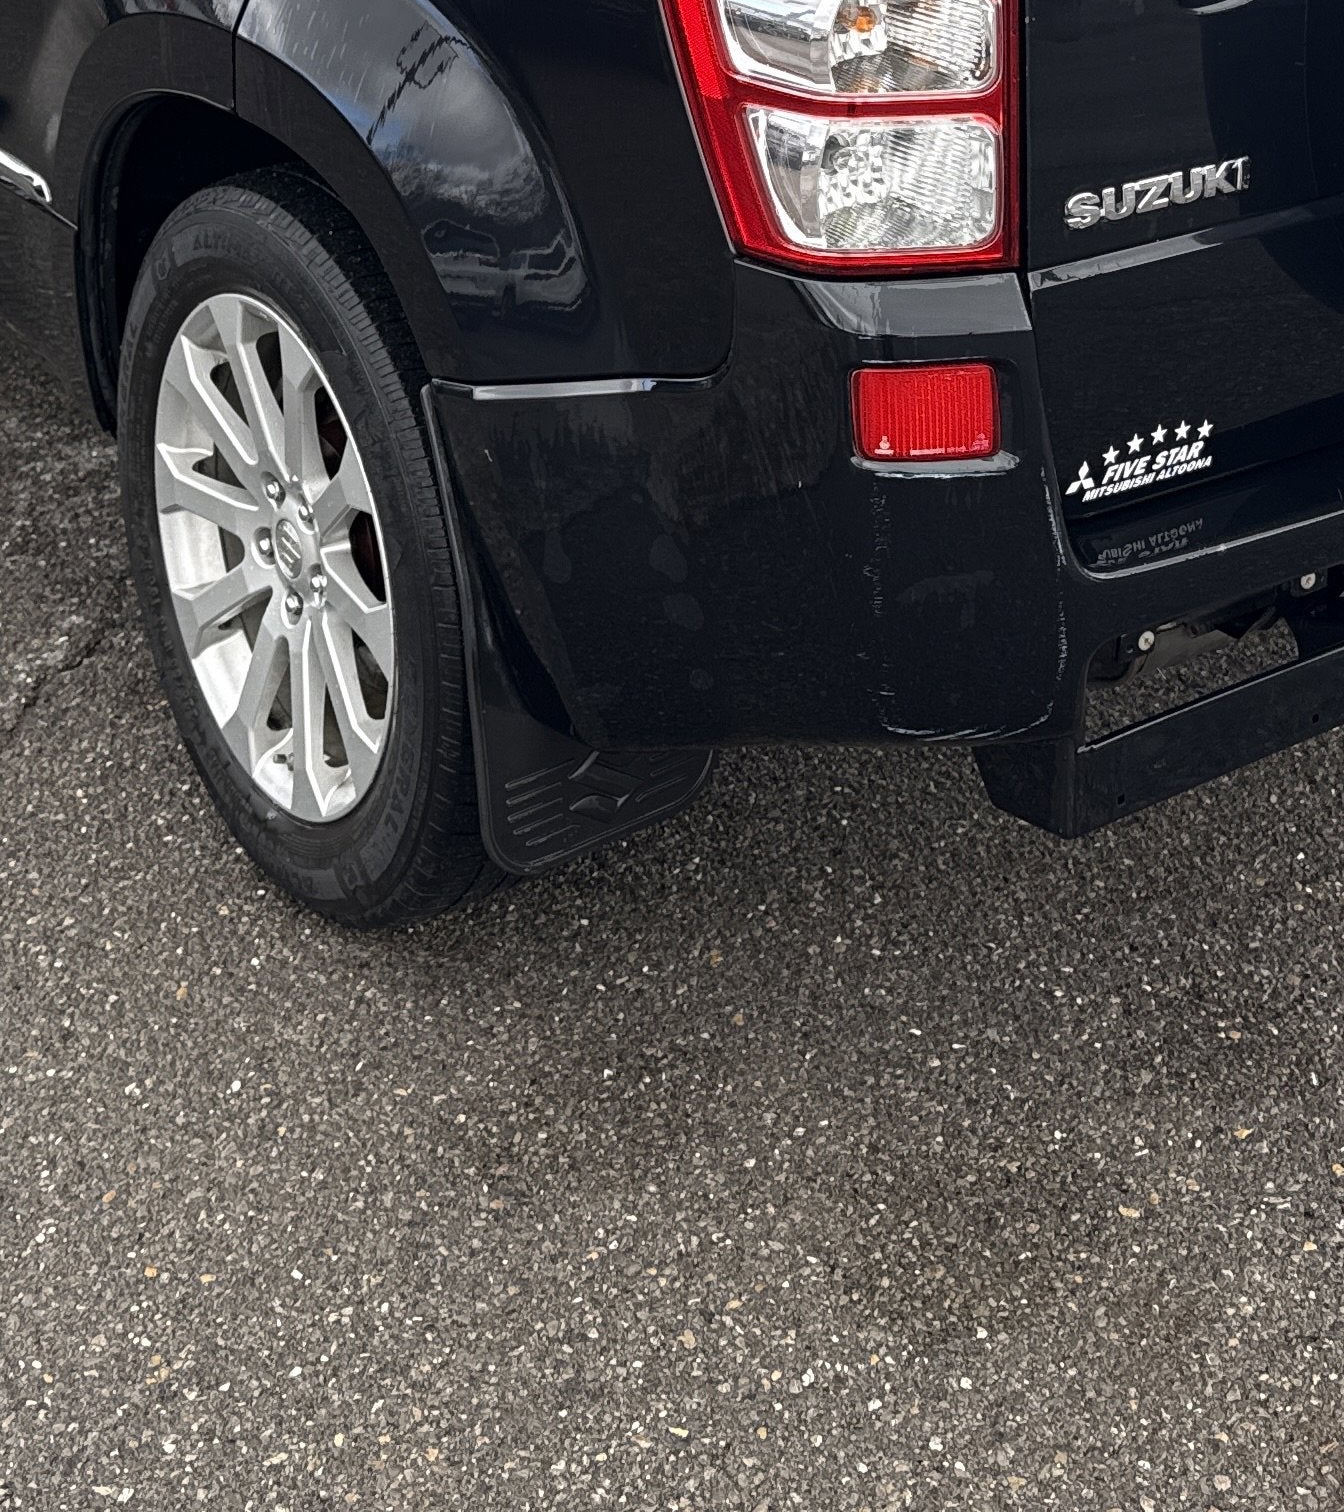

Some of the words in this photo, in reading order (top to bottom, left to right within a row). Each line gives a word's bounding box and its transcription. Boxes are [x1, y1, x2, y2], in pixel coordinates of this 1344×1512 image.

[1063, 155, 1251, 230] SUZUKI
[1082, 471, 1157, 502] MITSUBISHI
[1156, 456, 1213, 481] ALTOONA
[1101, 455, 1152, 484] FIVE
[1152, 440, 1205, 470] STAR
